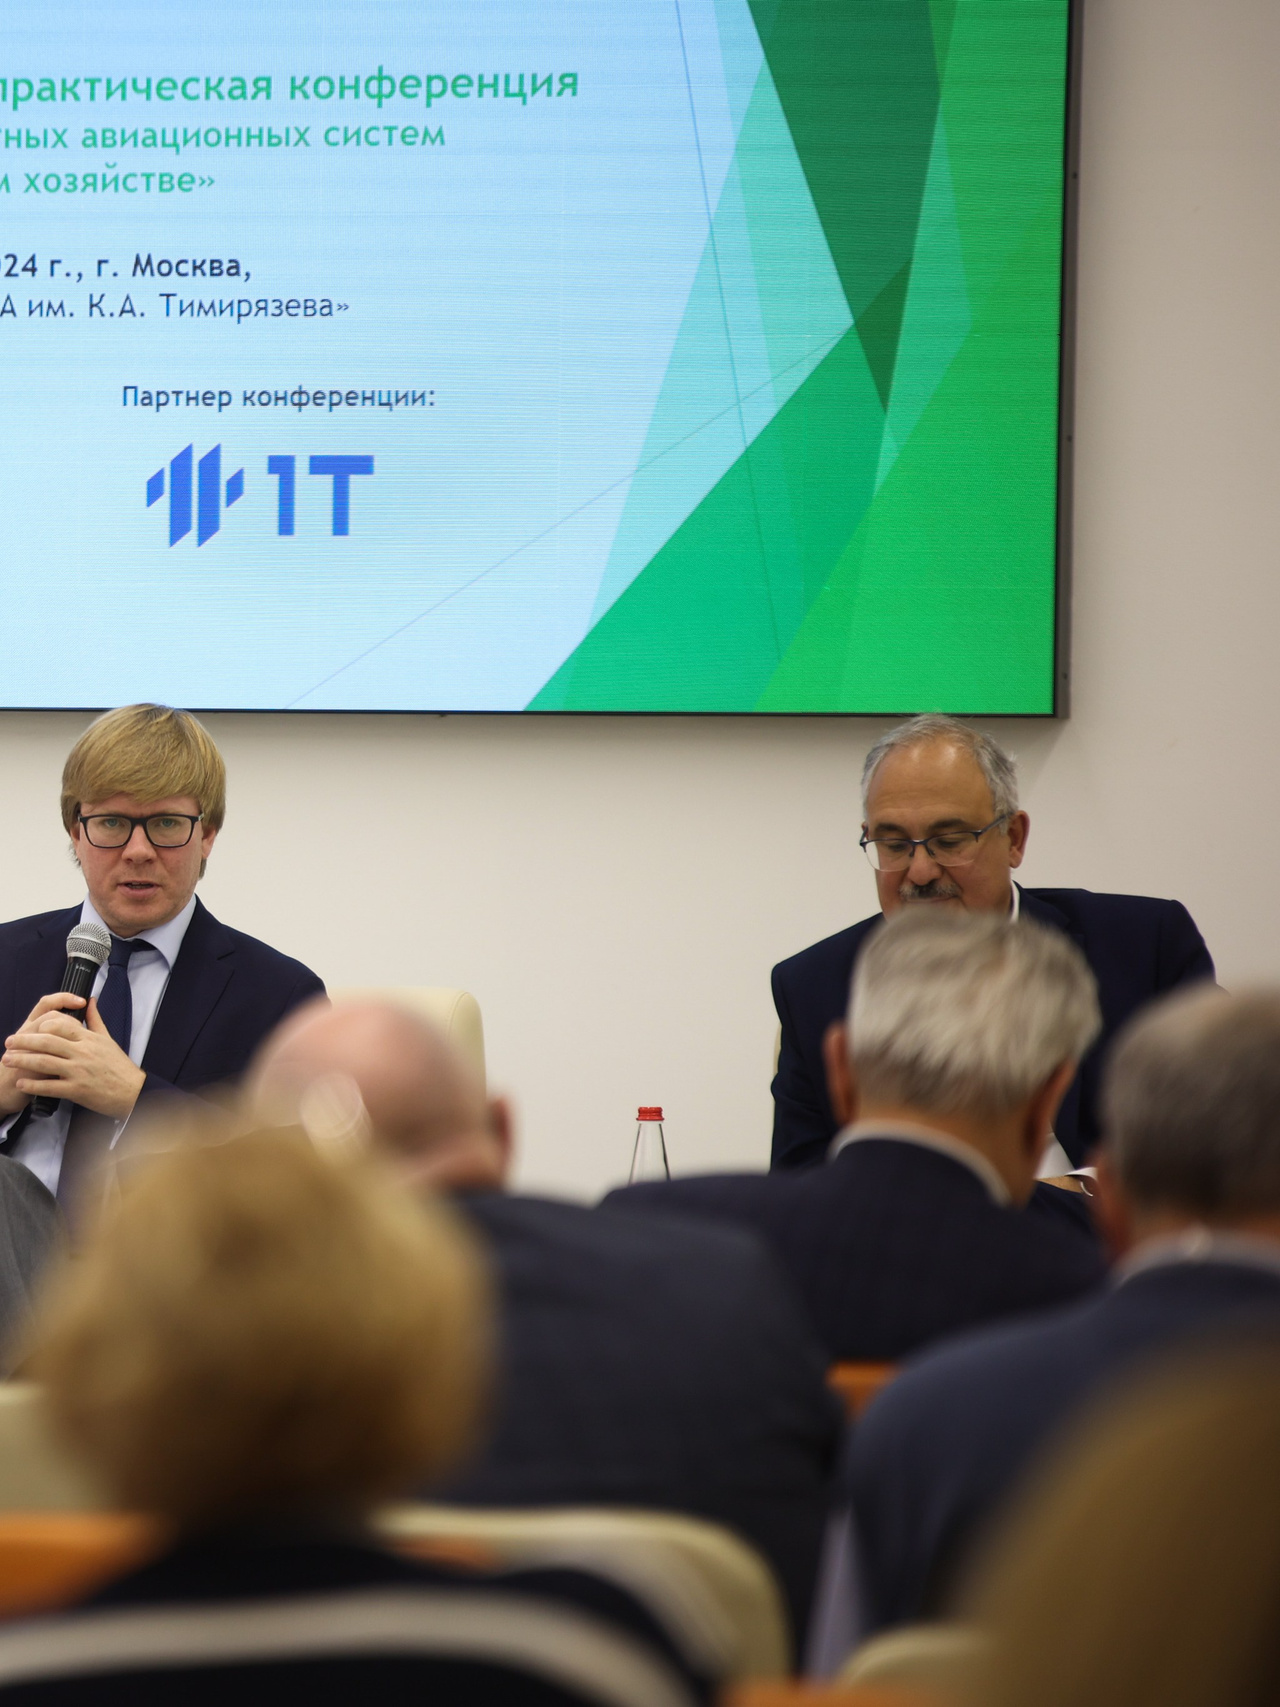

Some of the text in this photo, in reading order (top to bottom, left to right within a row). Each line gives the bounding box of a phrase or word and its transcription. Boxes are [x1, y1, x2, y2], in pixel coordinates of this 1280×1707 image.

[289, 64, 579, 110] конференция
[80, 126, 311, 155] авиационных
[323, 124, 446, 148] систем
[23, 162, 216, 194] хозяйстве»
[49, 258, 84, 283] г.,
[96, 258, 119, 278] г.
[131, 252, 252, 282] Москва,
[27, 299, 75, 318] им.
[88, 292, 146, 318] К.А.
[158, 292, 350, 325] Тимирязева»
[122, 383, 435, 413] Партнер конференции:
